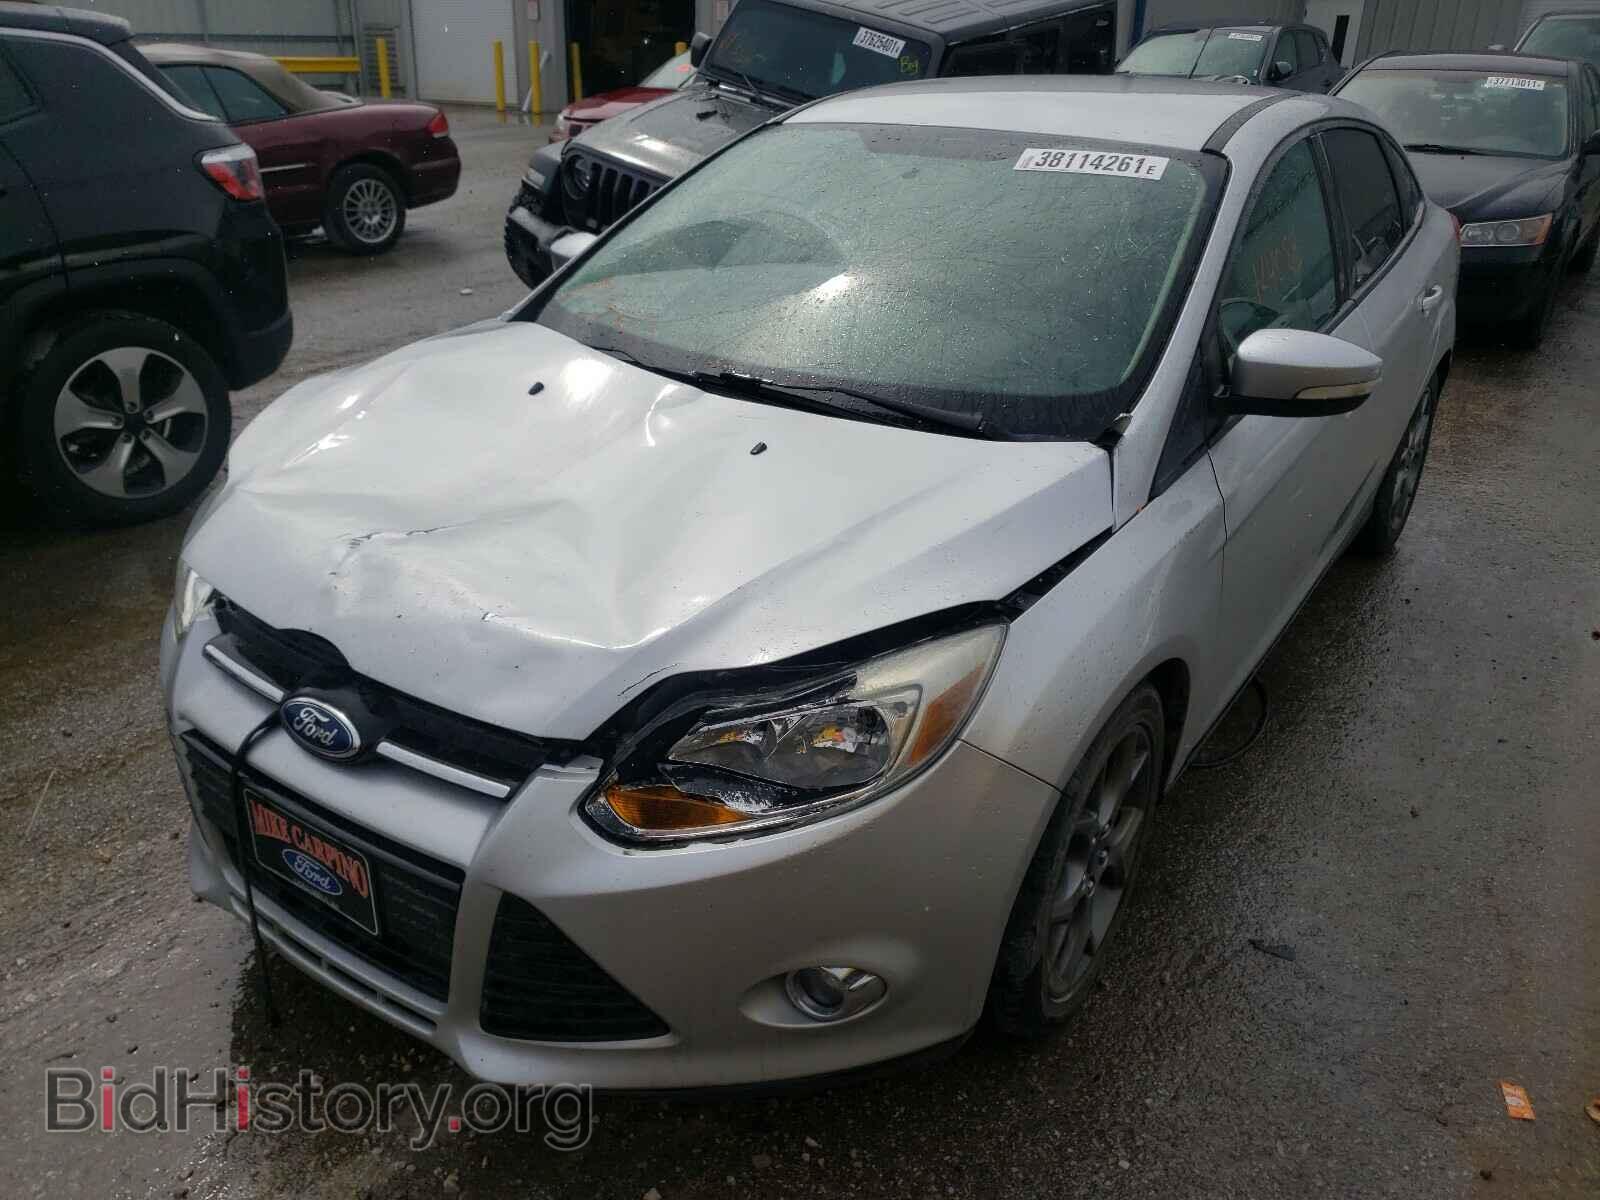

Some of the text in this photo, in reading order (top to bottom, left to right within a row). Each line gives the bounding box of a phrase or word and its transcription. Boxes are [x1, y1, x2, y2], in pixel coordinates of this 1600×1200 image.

[1035, 151, 1146, 174] 38114261
[293, 707, 338, 746] Ford
[250, 799, 291, 843] MIKE
[291, 825, 369, 898] CARPINO
[294, 855, 332, 889] Ford
